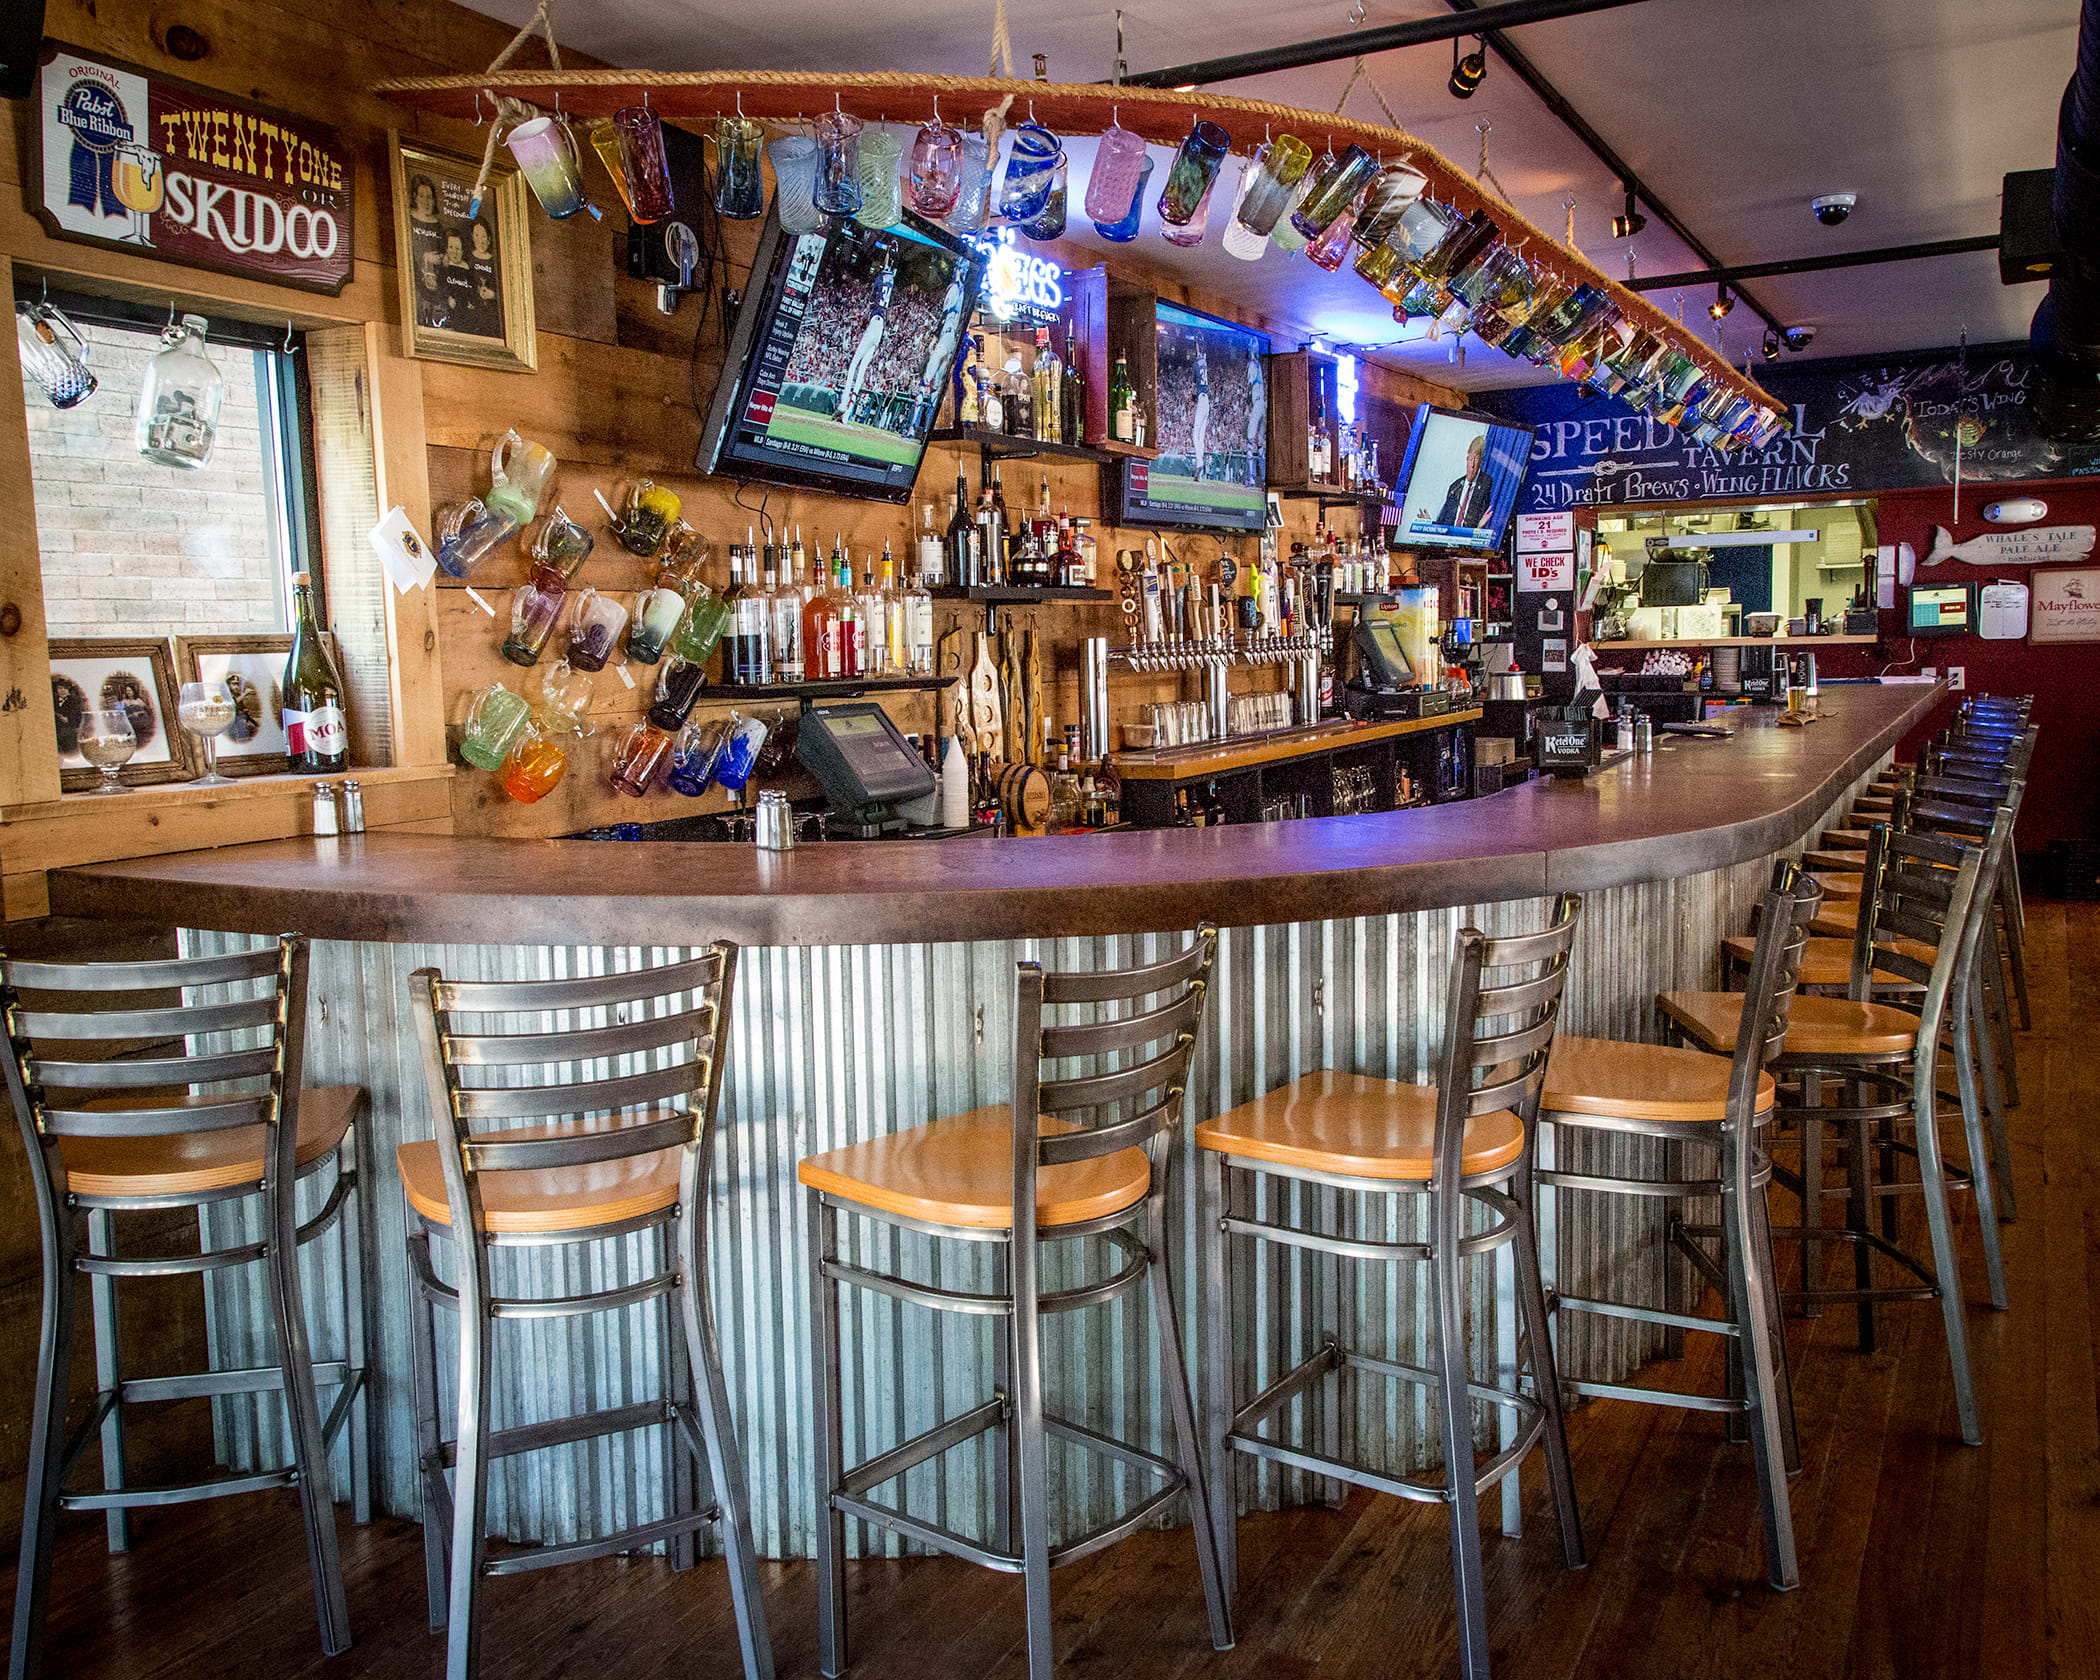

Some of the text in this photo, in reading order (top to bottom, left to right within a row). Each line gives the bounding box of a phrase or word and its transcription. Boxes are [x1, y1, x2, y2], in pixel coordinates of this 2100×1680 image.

[69, 66, 120, 90] ORIGINAL
[74, 88, 115, 117] Pabst
[60, 107, 132, 141] Blue Ribbon
[160, 110, 342, 190] TWENTY ONE
[165, 171, 338, 258] SKIDOO
[1979, 390, 2026, 410] WING
[1682, 437, 1820, 468] TAVERN
[1988, 448, 2023, 464] Orange
[1532, 483, 1556, 505] 24
[1561, 478, 1616, 505] Draft
[1624, 472, 1690, 499] Brews
[1760, 463, 1850, 492] FLAVORS
[1538, 521, 1551, 529] 21
[1986, 531, 2077, 543] WHALE'S TALE
[2001, 544, 2061, 554] PALE ALE
[1525, 556, 1565, 568] WE CHECK
[1532, 567, 1559, 578] ID's
[308, 719, 345, 741] MOA
[1545, 736, 1585, 754] Ketel One
